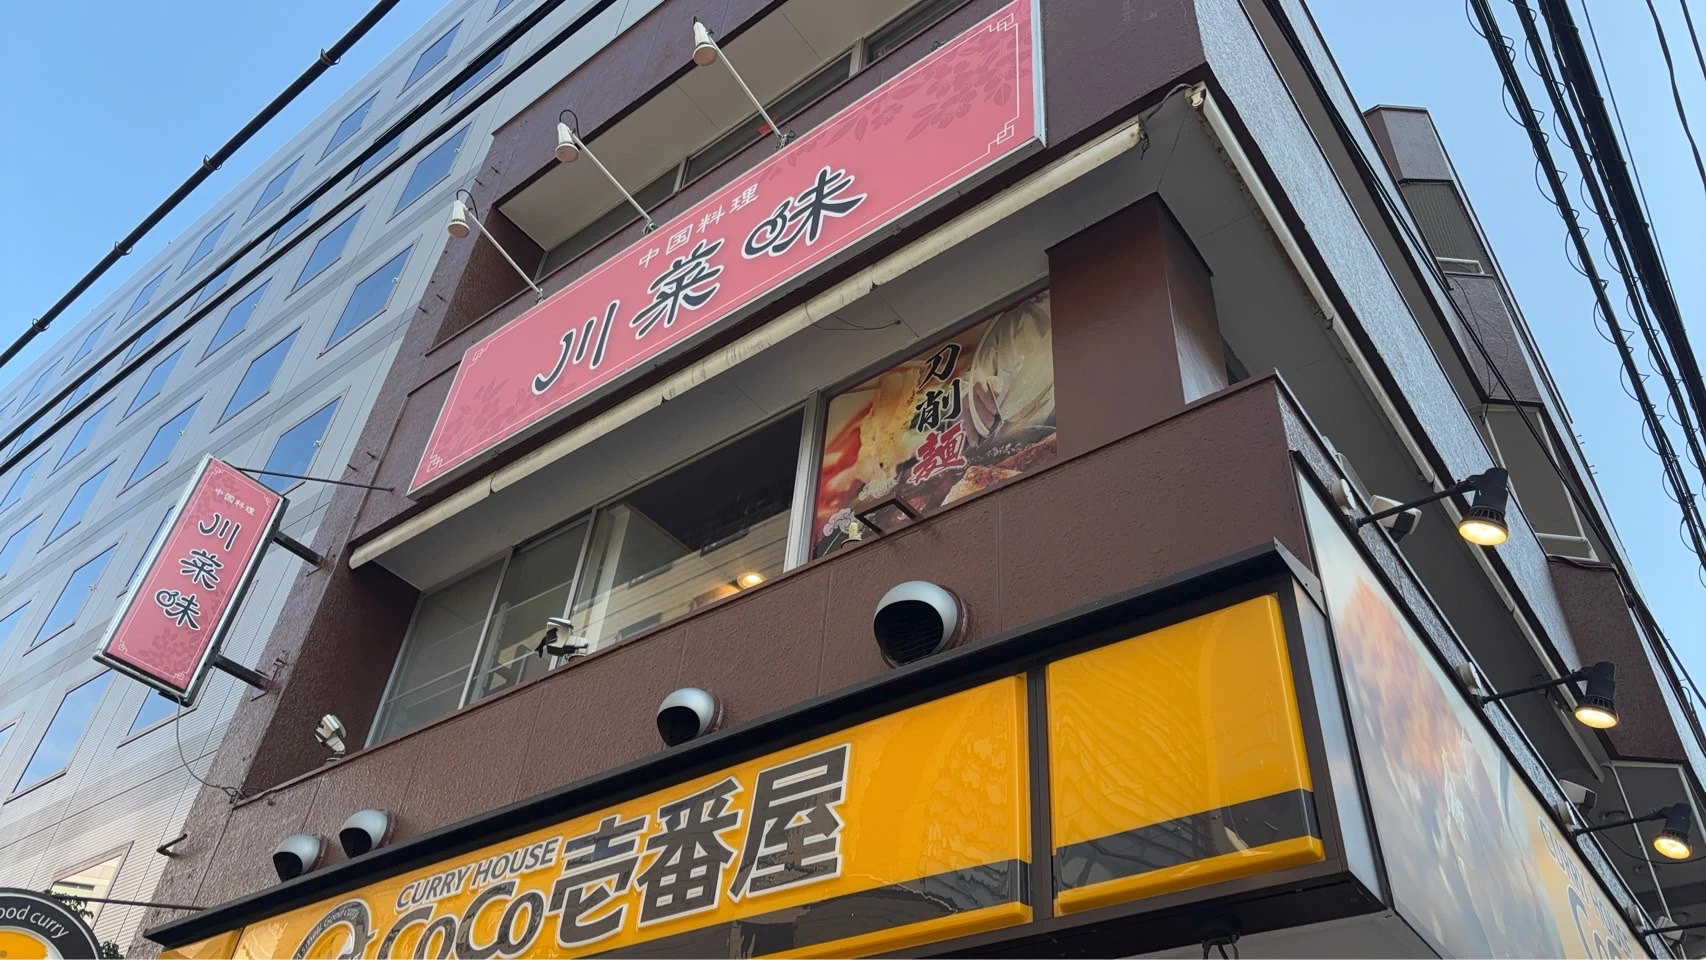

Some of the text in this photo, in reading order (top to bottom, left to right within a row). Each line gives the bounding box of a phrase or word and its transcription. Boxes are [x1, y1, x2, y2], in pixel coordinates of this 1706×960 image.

[639, 183, 759, 269] 中国料理
[532, 166, 867, 395] 川菜味
[215, 488, 256, 516] 中国料理
[155, 512, 241, 630] 川菜味
[396, 836, 563, 914] CURRY HOUSE
[30, 912, 69, 939] curry
